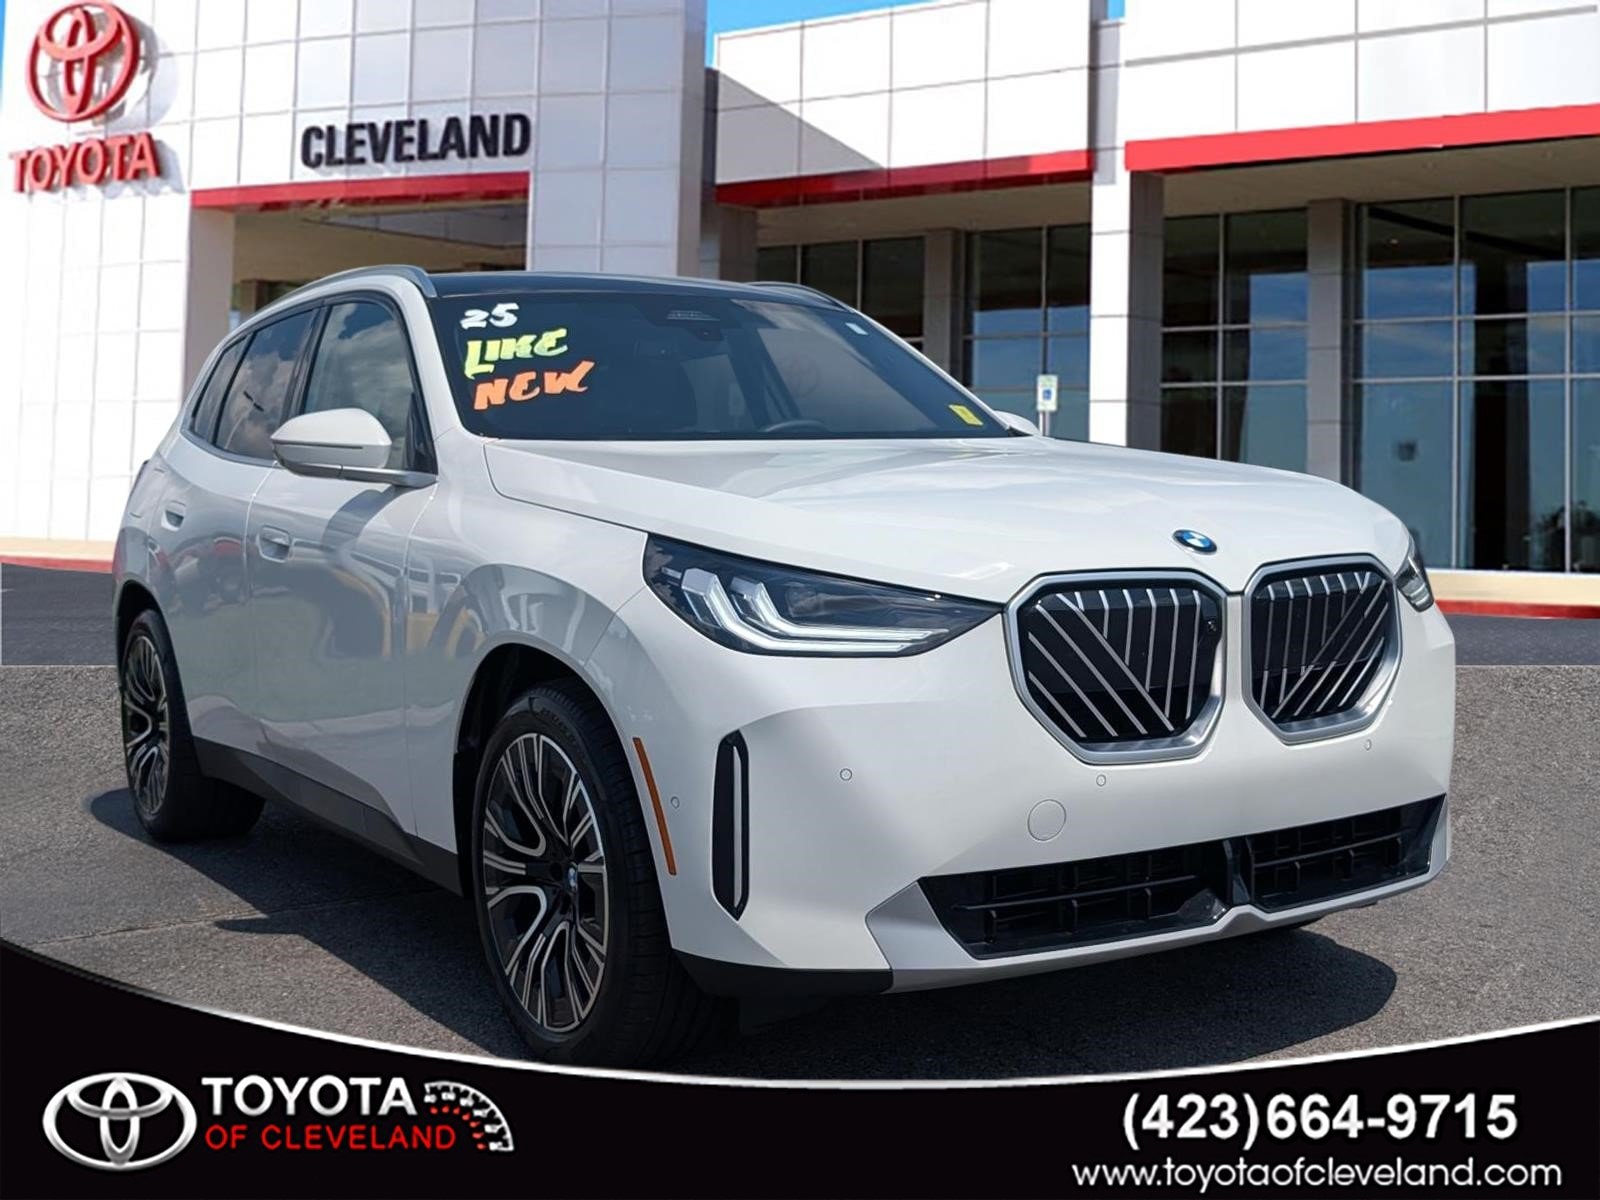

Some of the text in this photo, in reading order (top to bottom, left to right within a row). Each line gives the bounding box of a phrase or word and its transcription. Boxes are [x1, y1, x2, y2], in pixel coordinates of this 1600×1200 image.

[9, 132, 161, 193] TOYOTA
[301, 113, 531, 169] CLEVELAND
[460, 302, 520, 330] 25
[464, 327, 568, 380] LIKE
[473, 360, 596, 411] NEW
